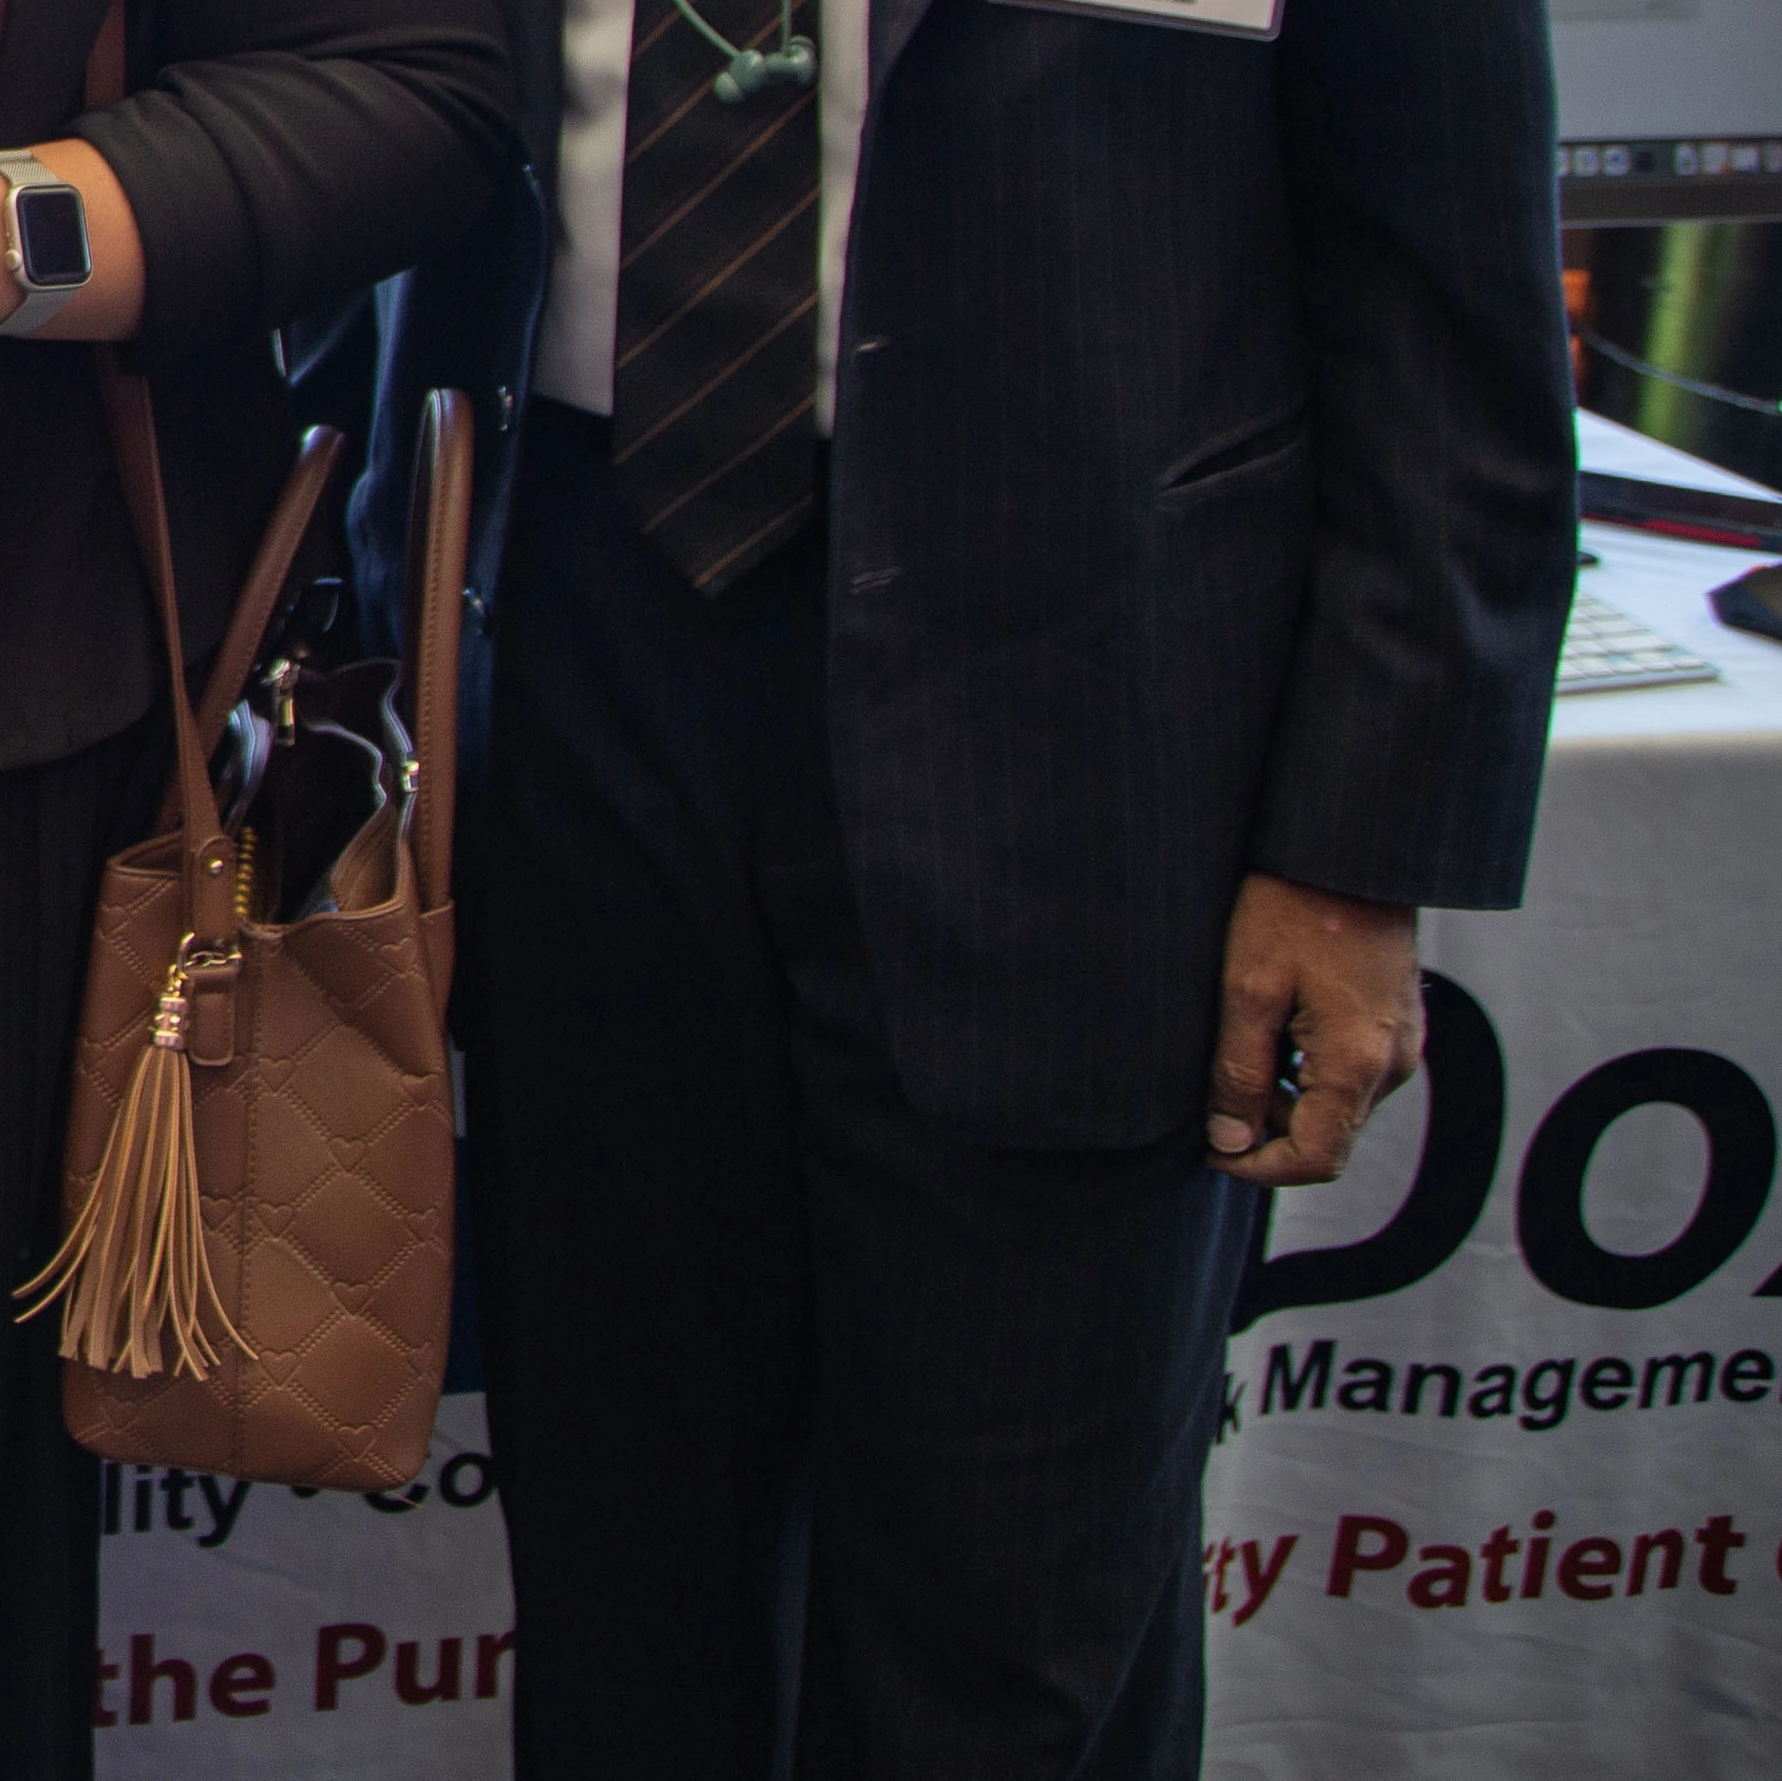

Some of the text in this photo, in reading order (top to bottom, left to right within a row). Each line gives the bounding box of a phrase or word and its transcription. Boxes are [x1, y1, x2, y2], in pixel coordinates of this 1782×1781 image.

[1227, 968, 1782, 1336] Do
[1258, 1338, 1782, 1432] Manageme
[1326, 1508, 1745, 1611] Patient
